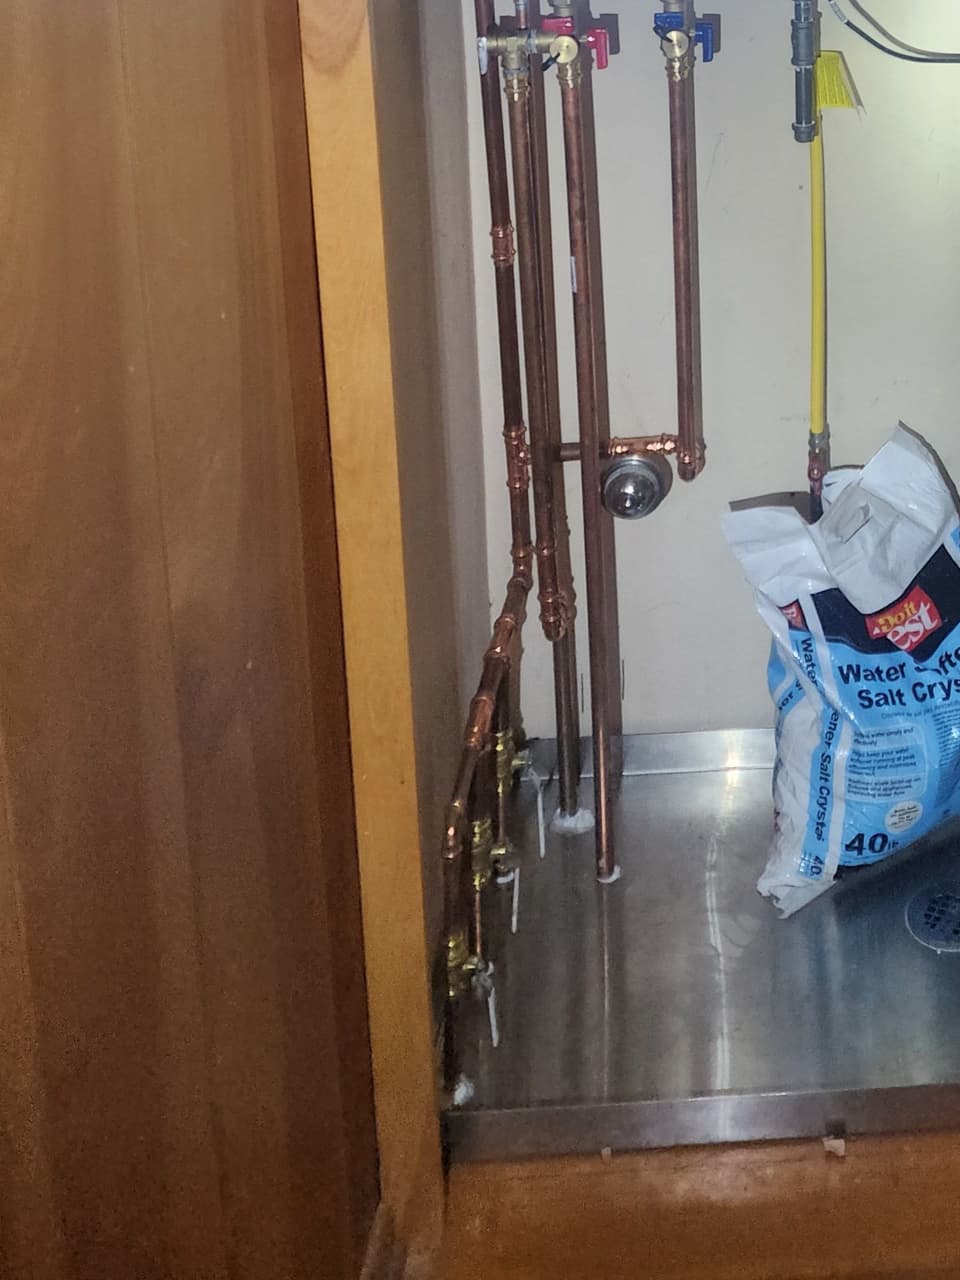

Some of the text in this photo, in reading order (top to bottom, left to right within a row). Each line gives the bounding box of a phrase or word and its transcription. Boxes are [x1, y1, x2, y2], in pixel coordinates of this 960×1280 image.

[886, 601, 938, 650] est
[800, 637, 818, 687] Water
[837, 662, 907, 685] Water
[857, 689, 907, 709] Salt
[824, 710, 840, 749] ener
[819, 752, 832, 782] Salt
[844, 832, 889, 857] 40
